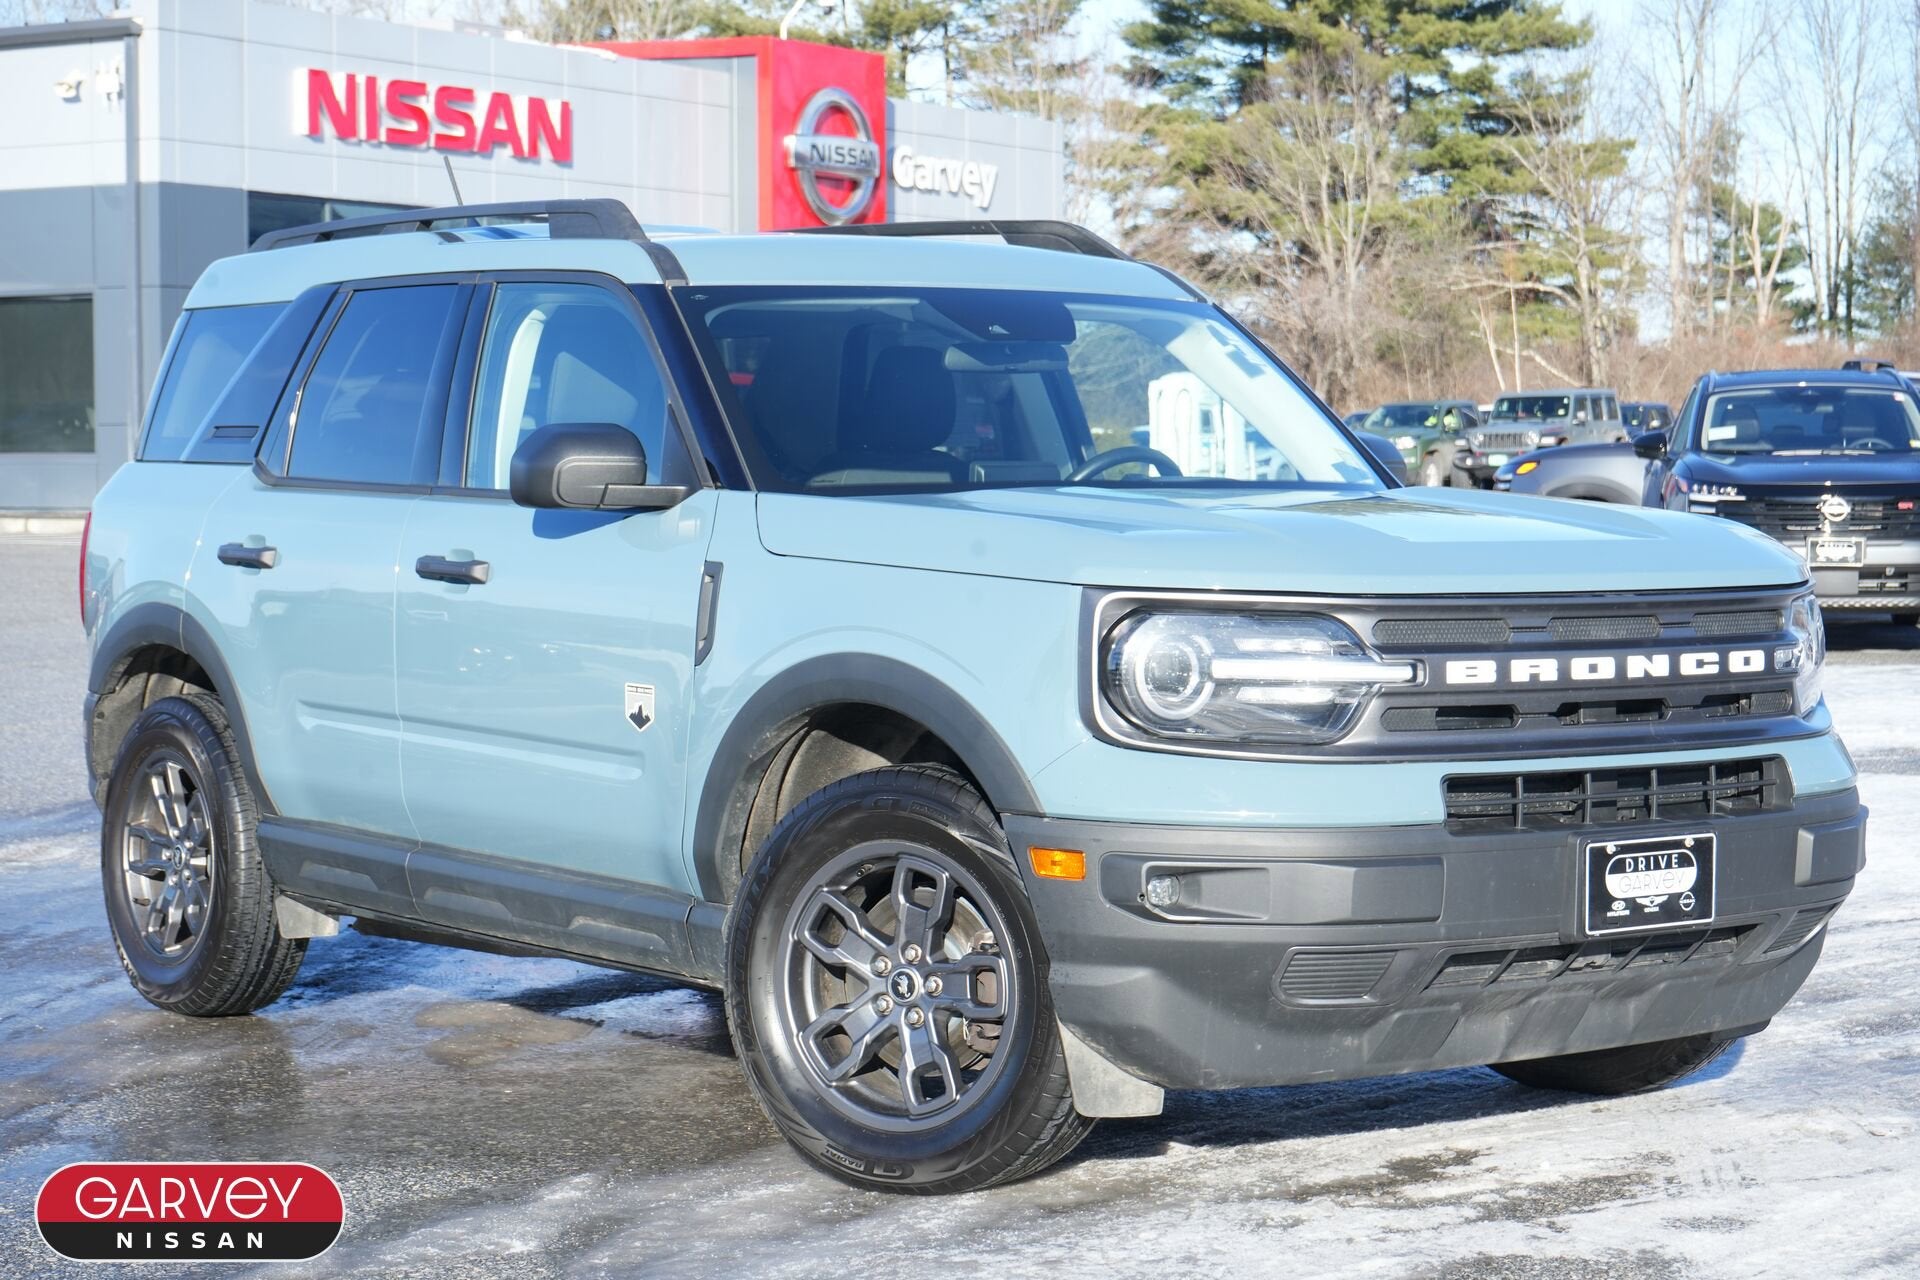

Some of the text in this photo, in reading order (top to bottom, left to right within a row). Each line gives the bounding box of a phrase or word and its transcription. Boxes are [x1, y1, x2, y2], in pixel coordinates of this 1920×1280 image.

[301, 68, 573, 164] NISSAN
[809, 142, 875, 172] NISSAN
[892, 144, 998, 209] Garvey
[1446, 650, 1765, 684] BRONCO
[1626, 854, 1679, 872] DRIVE
[1619, 871, 1684, 893] GARVEY
